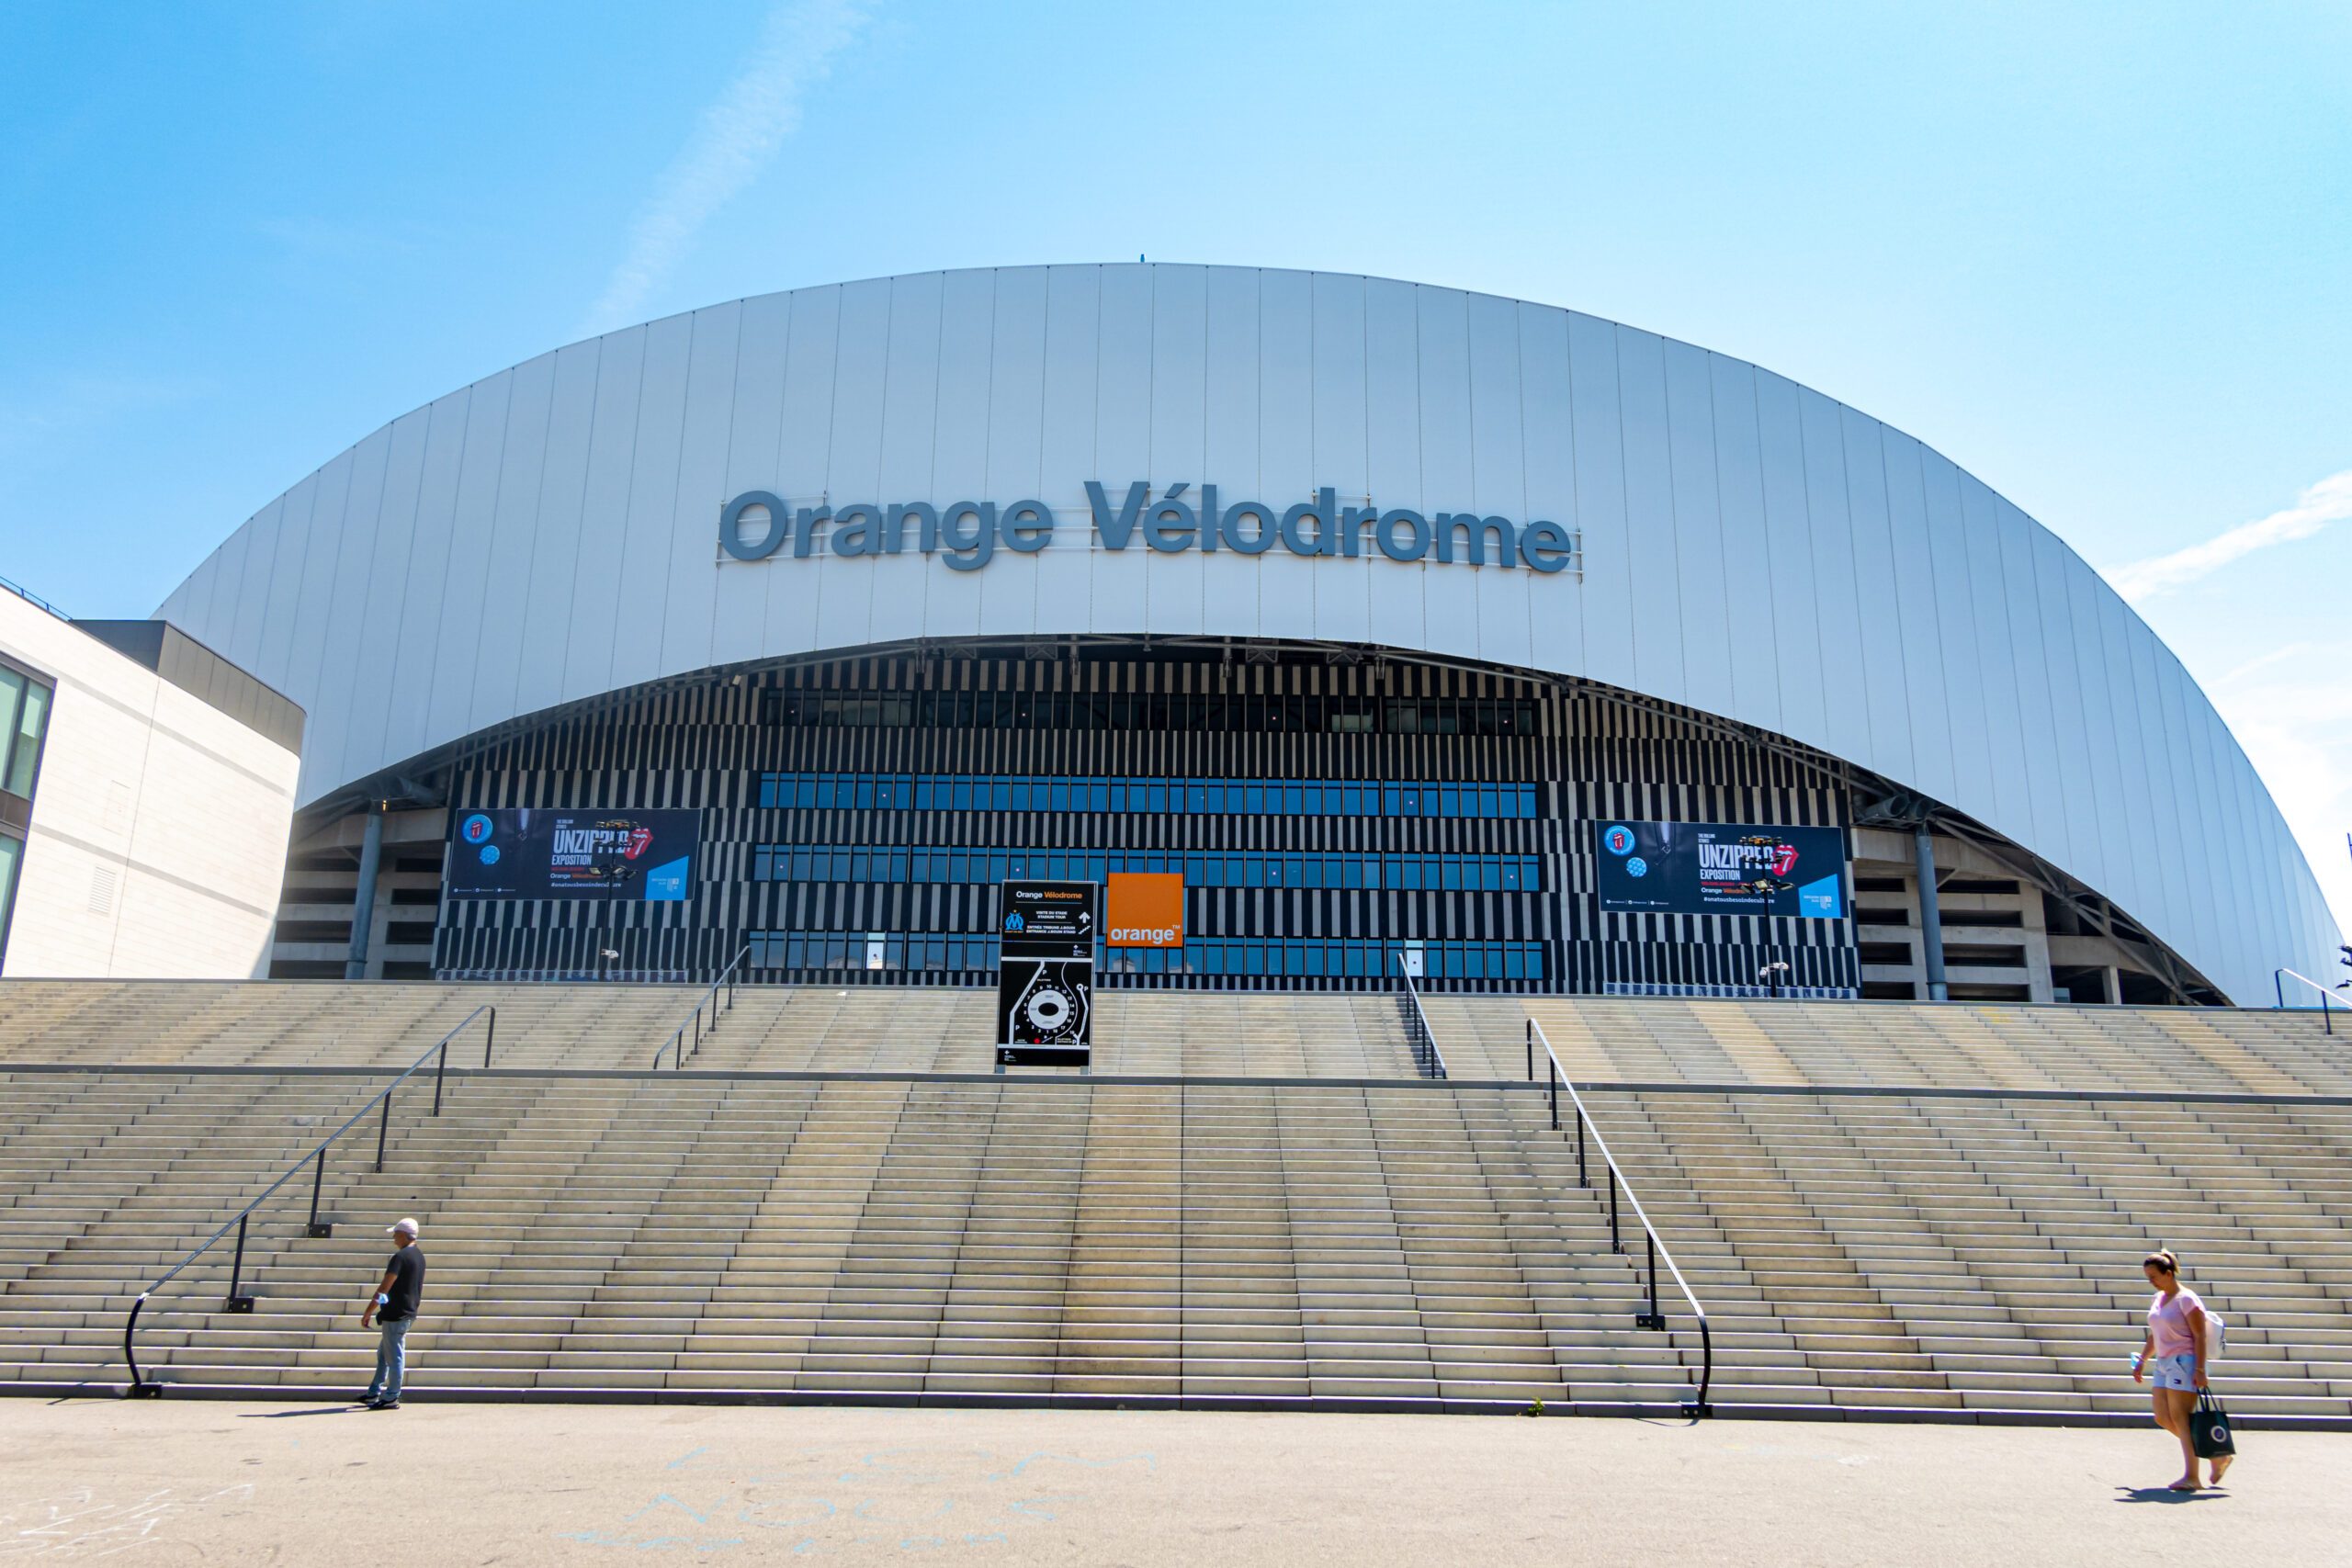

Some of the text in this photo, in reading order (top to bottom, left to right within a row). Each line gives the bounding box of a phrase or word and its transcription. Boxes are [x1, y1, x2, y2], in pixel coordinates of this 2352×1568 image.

[719, 481, 1571, 573] Orange Vélodrome
[551, 854, 593, 865] EXPOSITION
[1700, 869, 1741, 880] EXPOSITION
[1015, 891, 1083, 899] Orange Vélodrome
[1110, 928, 1175, 945] orange
